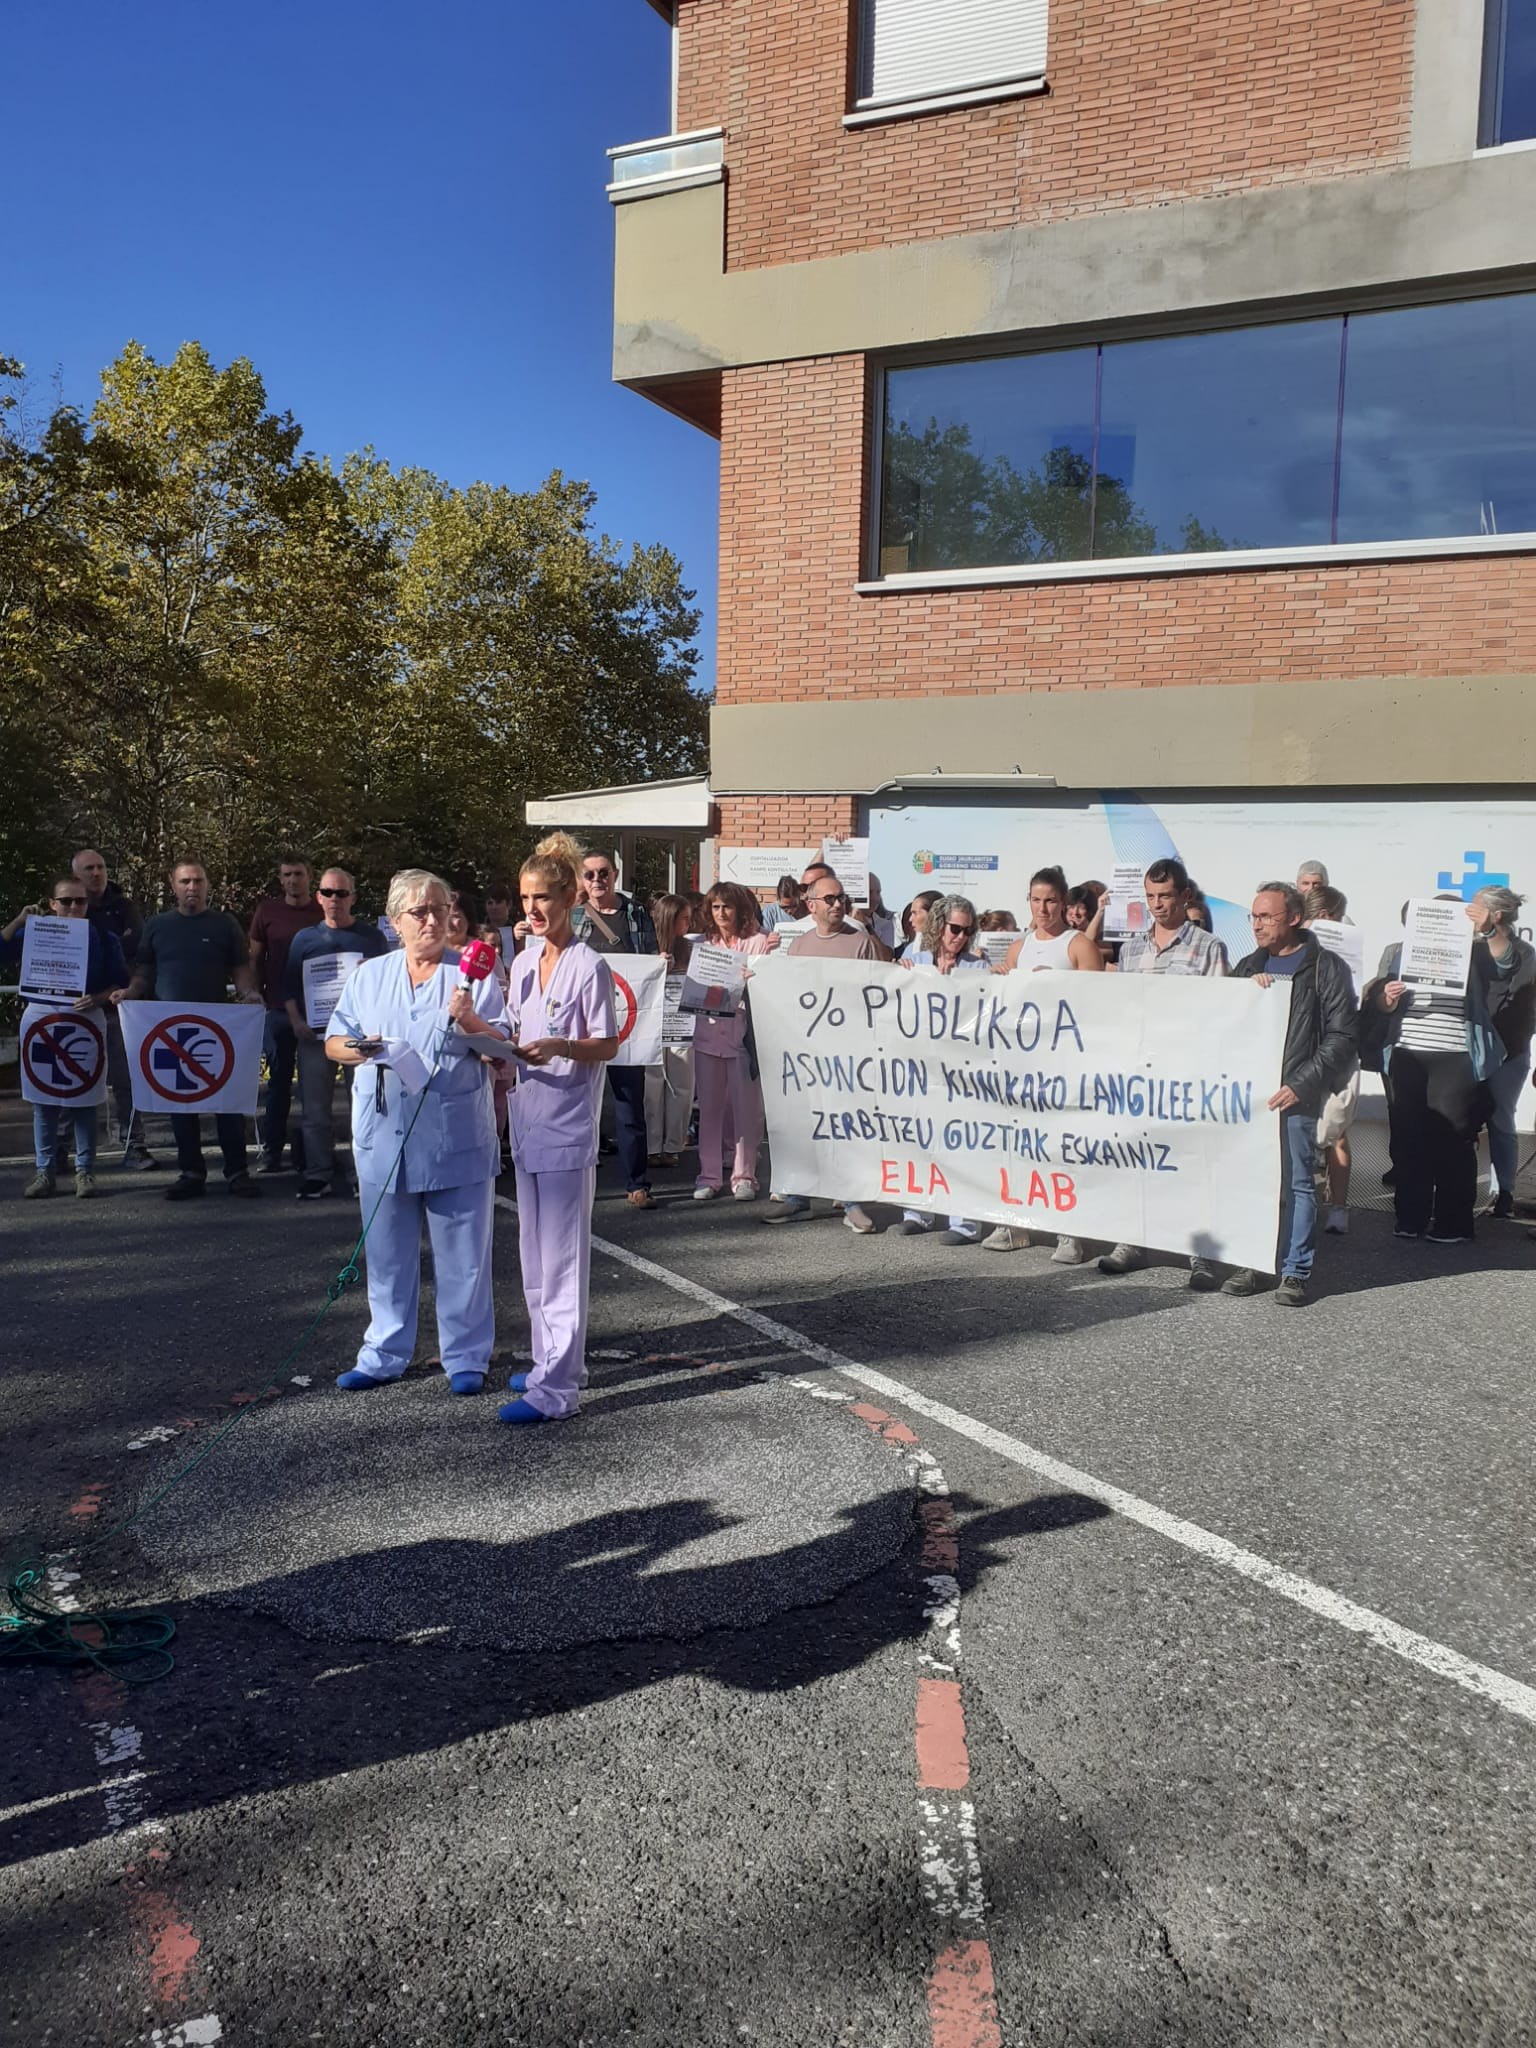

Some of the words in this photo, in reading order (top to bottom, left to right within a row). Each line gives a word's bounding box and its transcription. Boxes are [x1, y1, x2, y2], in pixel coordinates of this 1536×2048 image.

[799, 987, 845, 1037] %
[862, 985, 1085, 1052] PUBLIKOA
[782, 1047, 928, 1097] ASUNCION
[941, 1060, 1067, 1113] KLINIKAKO
[1079, 1063, 1252, 1124] LANGILEEKIN
[812, 1106, 933, 1149] ZERBITZU
[943, 1120, 1052, 1162] GUZTIAK
[1060, 1132, 1178, 1172] ESKAINIZ
[881, 1160, 951, 1196] ELA
[1000, 1167, 1077, 1212] LAB
